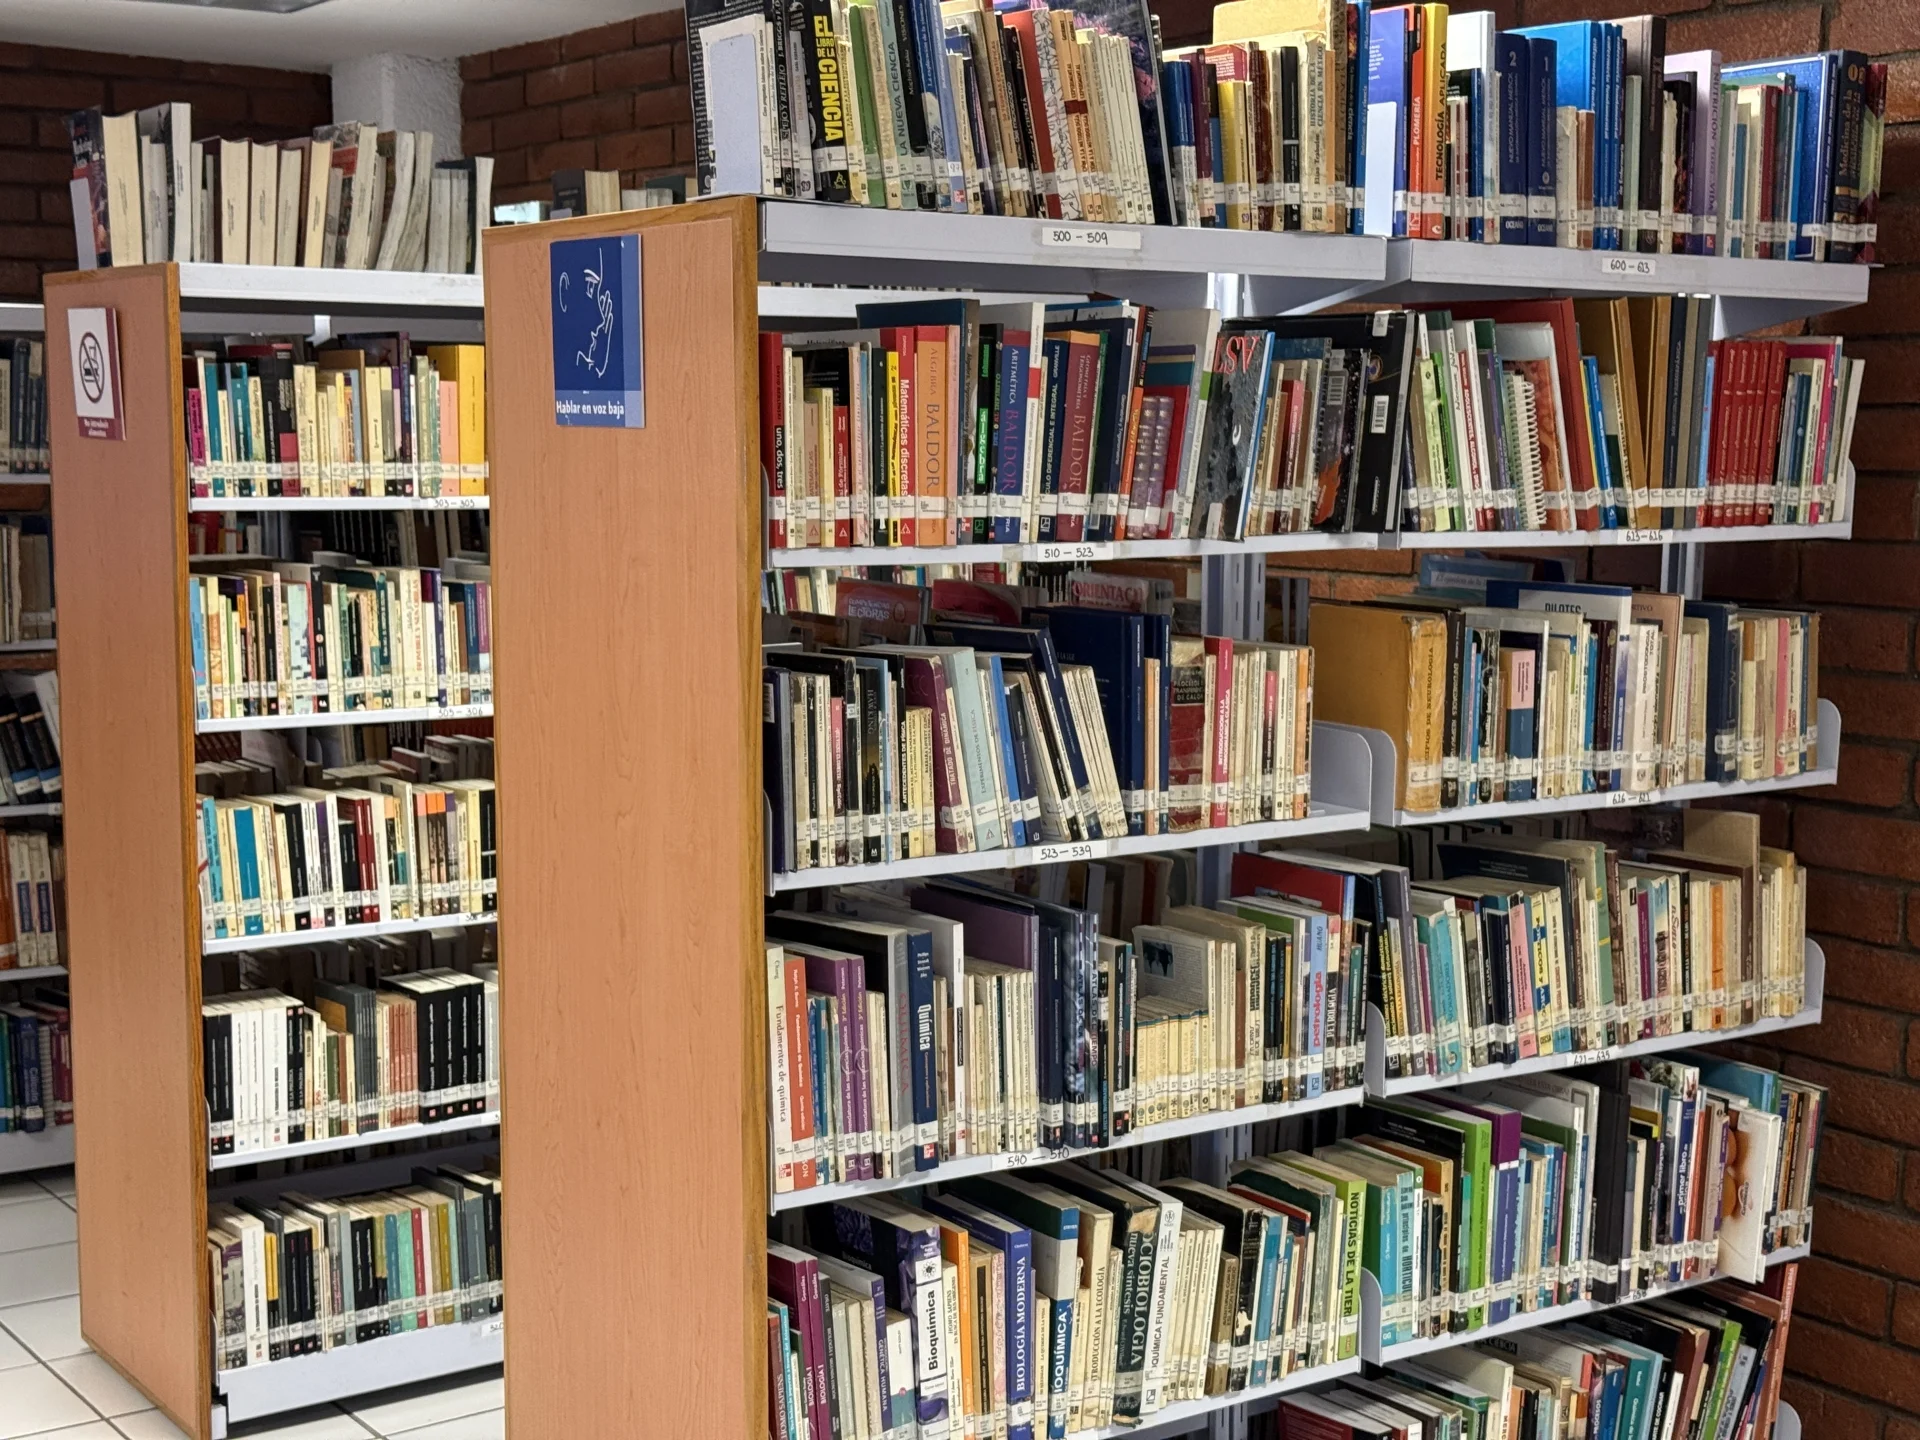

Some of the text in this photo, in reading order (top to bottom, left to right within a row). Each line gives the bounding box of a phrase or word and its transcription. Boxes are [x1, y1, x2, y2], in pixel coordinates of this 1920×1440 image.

[814, 15, 834, 37] EL
[816, 38, 834, 47] LIBRO
[898, 5, 908, 41] VISIONES
[817, 48, 835, 58] DE LA
[1309, 62, 1316, 86] DE LA
[1510, 50, 1517, 67] 2
[778, 64, 787, 102] REFLEJO
[818, 58, 844, 141] CIENCIA
[888, 42, 908, 156] LA NUEVA CIENCIA
[905, 69, 914, 95] Michio
[1317, 82, 1323, 91] EN
[1710, 72, 1720, 140] NUTRICIÓN
[1412, 96, 1421, 146] PLOMERÍA
[1435, 41, 1447, 180] TECNOLOGÍA APLICADA
[1839, 121, 1850, 176] Medicina
[1708, 183, 1716, 211] VIDA
[1053, 230, 1108, 245] 500 509
[1610, 259, 1626, 271] 600
[1075, 355, 1086, 410] TRIGONOMETRÍA
[1083, 354, 1092, 392] GEOMETRÍA
[556, 400, 624, 420] Hablar en voz baja
[1002, 348, 1020, 492] ARITMÉTICA BALDOR
[1046, 383, 1057, 473] DIFERENCIAL INTEGRAL
[1115, 394, 1127, 465] Geometría Trigonometría
[1463, 389, 1478, 469] ADOLESCENTES, ALCOHOL
[775, 427, 784, 489] uno, dos, tres
[900, 379, 910, 496] Matemáticas discretas
[926, 403, 940, 494] BALDOR
[1068, 414, 1086, 490] BALDOR
[1044, 546, 1094, 558] 510 523
[1426, 647, 1434, 725] DE NEUROLOGÍA
[1641, 629, 1650, 694] PROSTODONCIA
[901, 743, 907, 752] DE
[940, 712, 956, 786] TRATADO DE DINÁMICA
[970, 710, 986, 794] EXPERIMENTOS DE FÍSICA
[1040, 845, 1092, 860] 523 539
[1378, 935, 1386, 971] domésticas
[1383, 929, 1394, 994] solares fotovoltaicas
[1394, 960, 1402, 997] ERGONOMÍA
[795, 1014, 803, 1054] Fundamentos
[918, 1004, 932, 1051] Química
[1078, 1008, 1084, 1022] DE
[1312, 971, 1322, 1048] petrología
[1326, 987, 1336, 1038] PETROLOGÍA
[773, 960, 788, 1123] Chang Fundamentos de química
[898, 992, 909, 1096] QUÍMICA
[1676, 1151, 1688, 1206] primer libro
[1127, 1233, 1138, 1268] nueva
[1344, 1192, 1360, 1286] NOTICIAS DE LA
[1096, 1266, 1105, 1306] ECOLOGÍA
[1154, 1256, 1170, 1325] FUNDAMENTAL
[1227, 1297, 1235, 1326] ESLABÓN
[927, 1290, 939, 1370] Bioquímica
[1015, 1256, 1026, 1391] BIOLOGÍA MODERNA
[1095, 1307, 1102, 1318] LA
[878, 1339, 888, 1412] GENÉTICA HUMANA
[1053, 1311, 1067, 1392] IOQUÍMICA
[777, 1374, 785, 1409] SAPIENS
[819, 1370, 827, 1404] BIOLOGÍA
